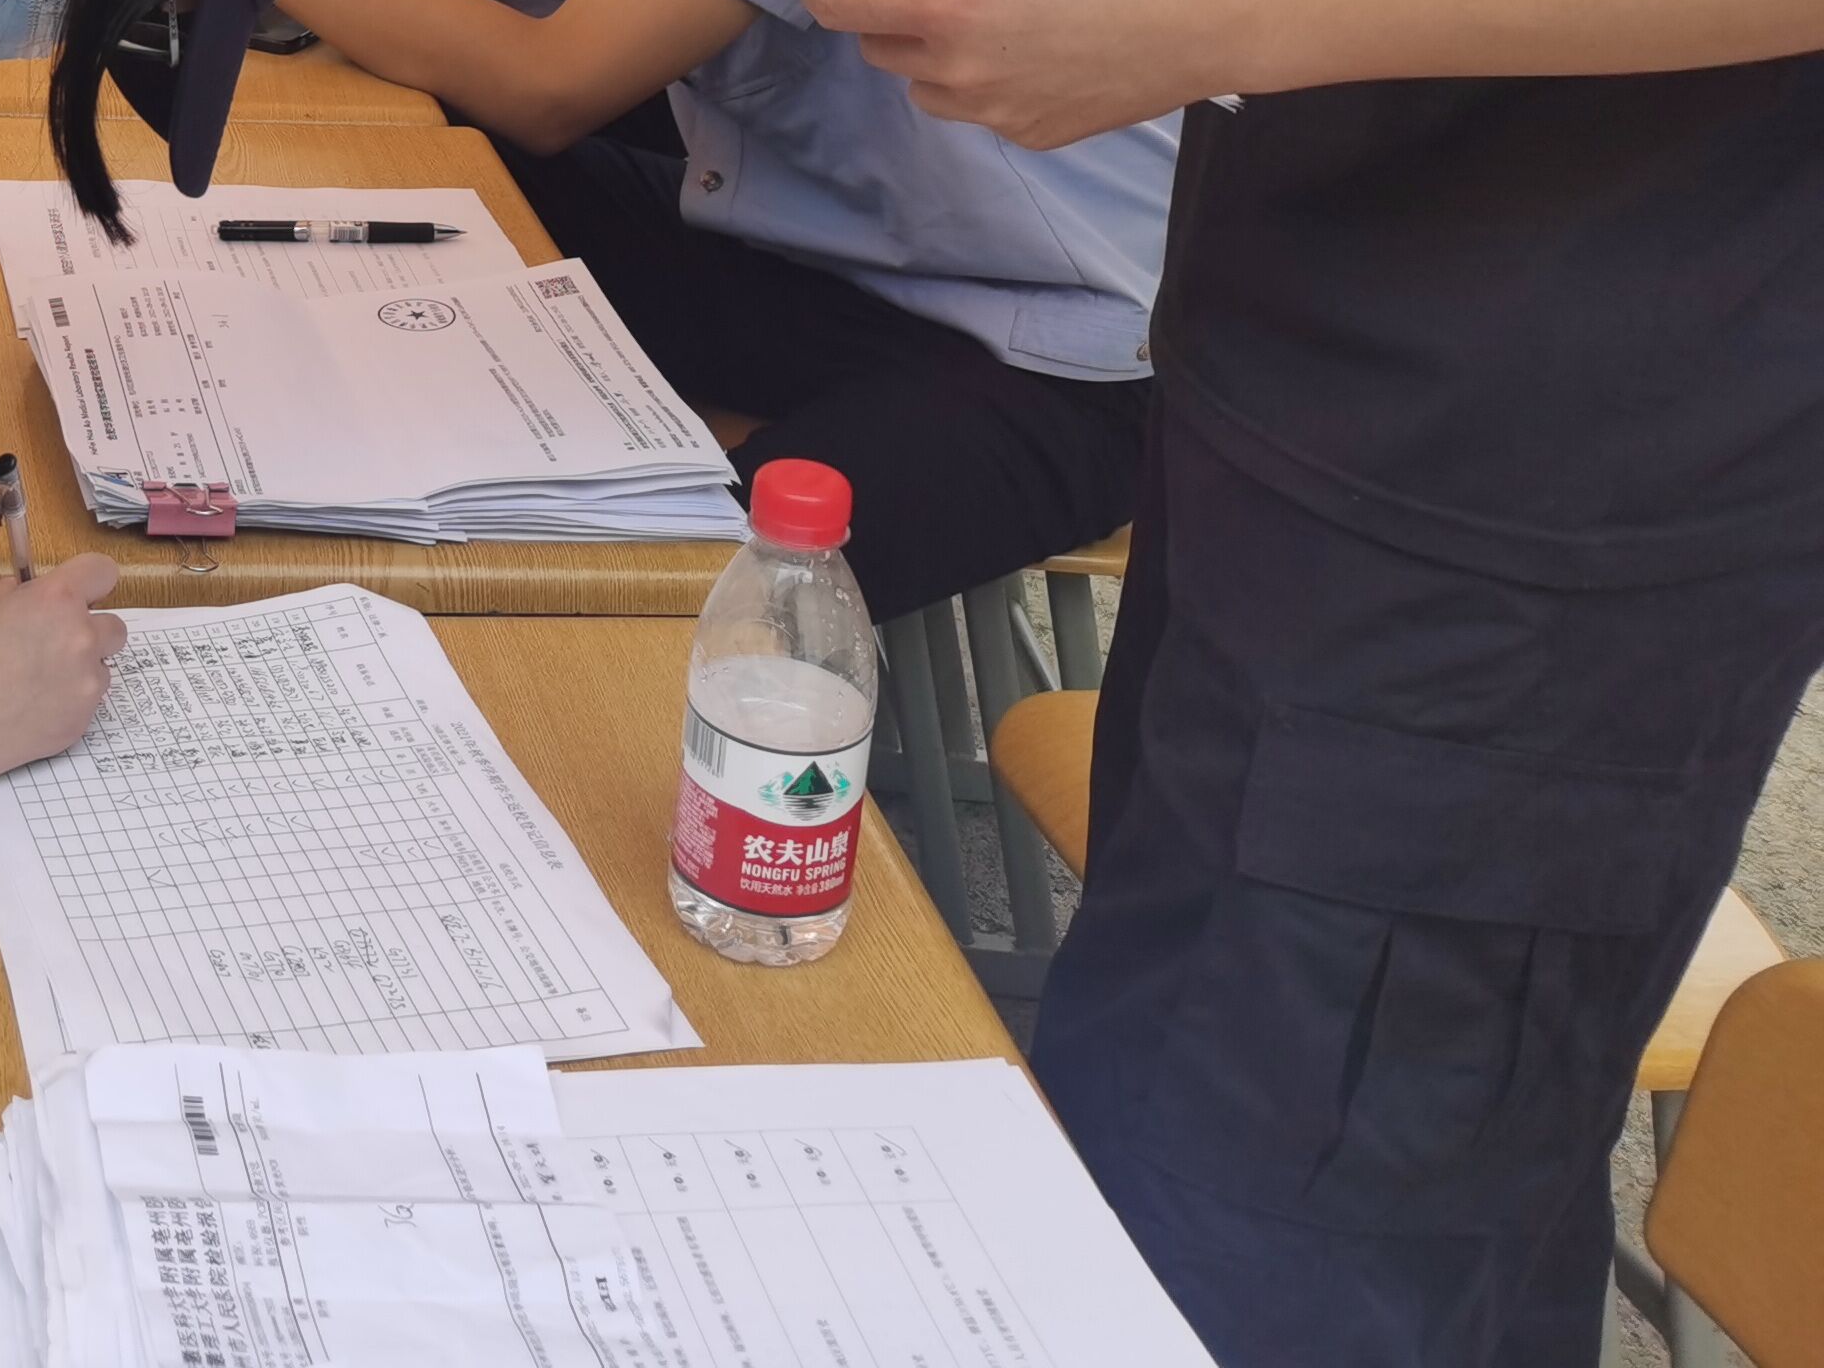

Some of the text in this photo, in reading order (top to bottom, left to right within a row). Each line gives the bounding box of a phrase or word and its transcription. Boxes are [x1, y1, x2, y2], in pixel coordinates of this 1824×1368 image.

[62, 335, 73, 352] Report
[71, 371, 85, 397] Laboratory
[79, 397, 89, 419] Medical
[743, 830, 849, 865] 农夫山泉
[741, 856, 846, 882] NONGFU SPRING
[740, 878, 793, 896] 饮用天然水
